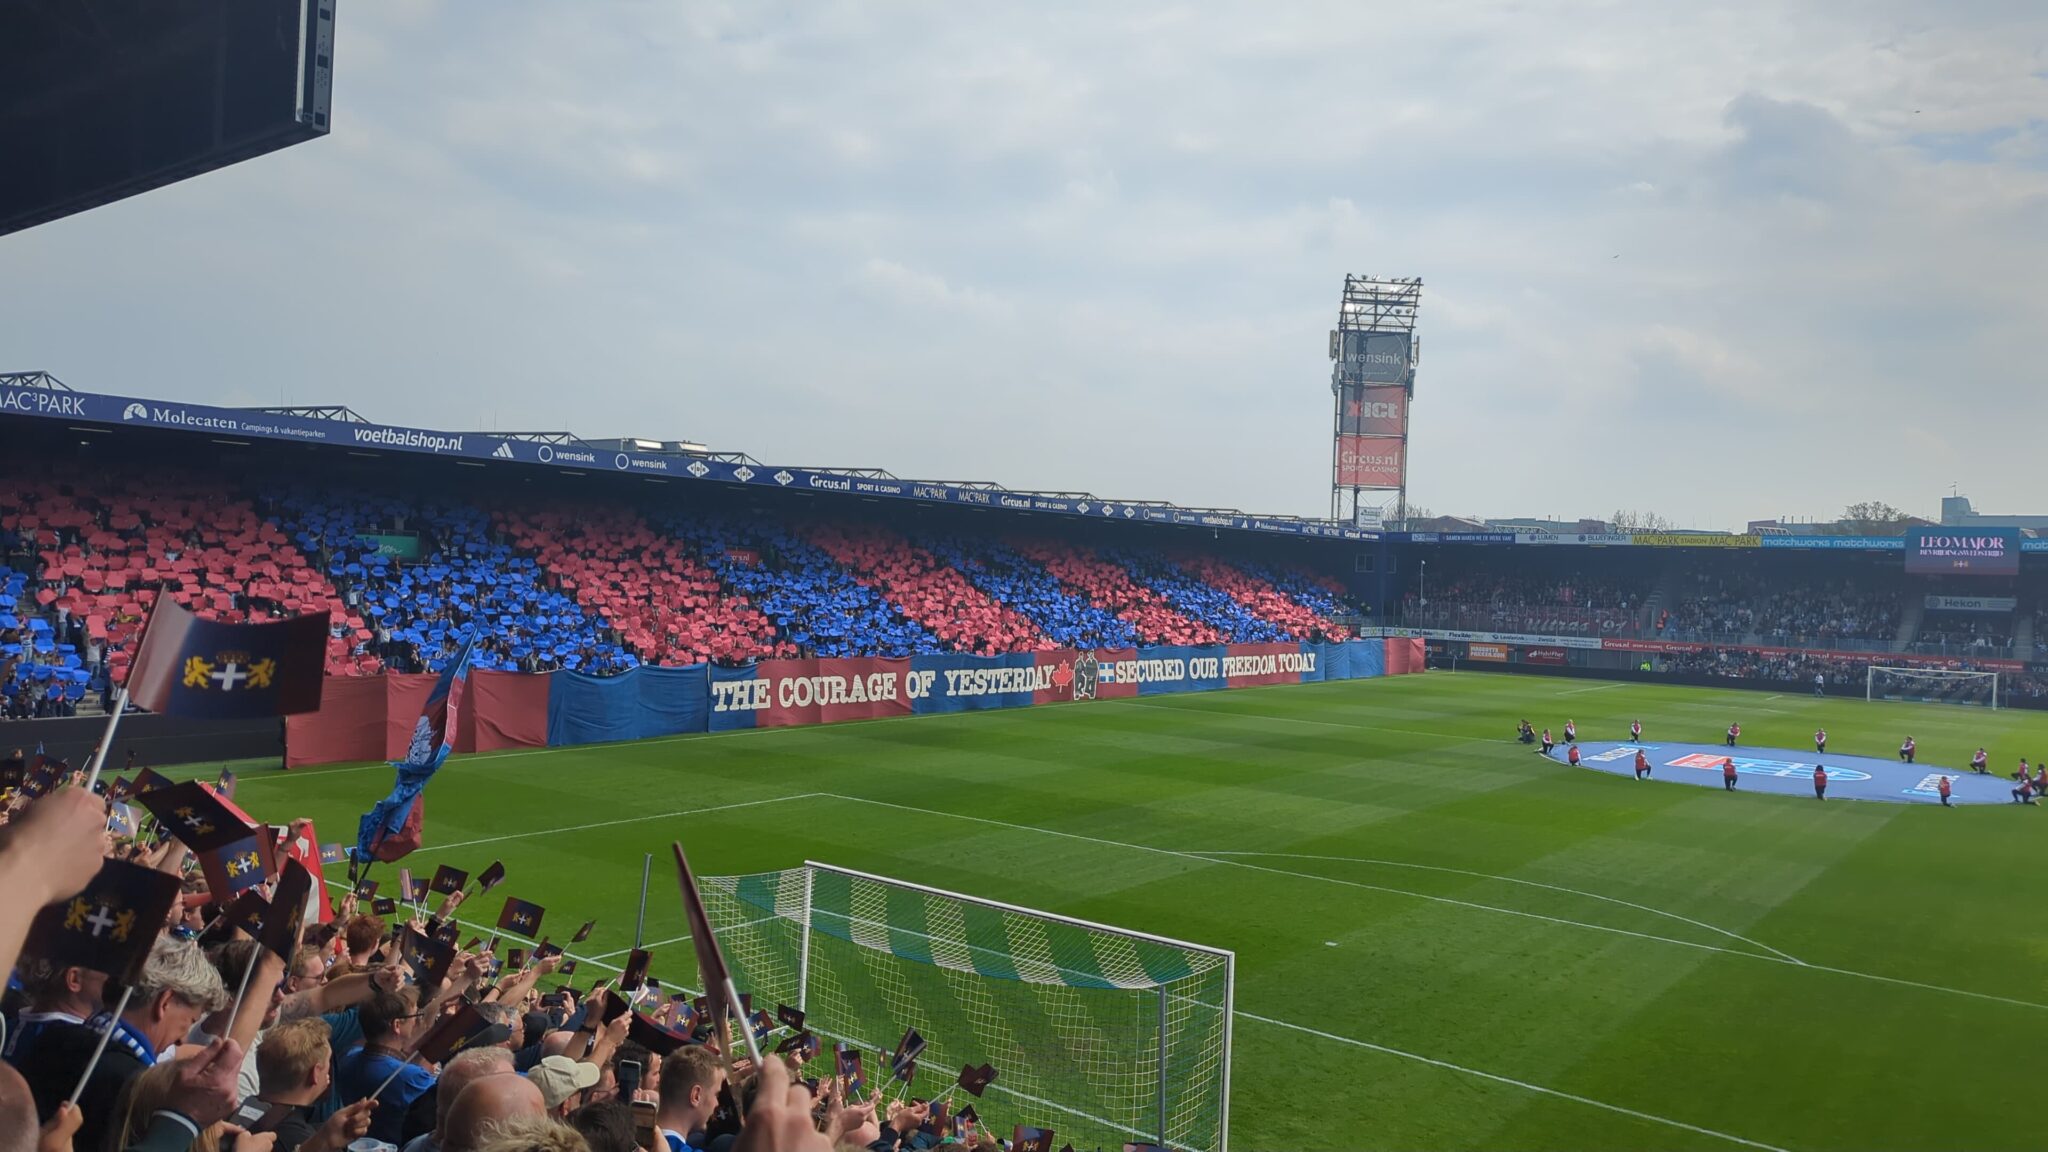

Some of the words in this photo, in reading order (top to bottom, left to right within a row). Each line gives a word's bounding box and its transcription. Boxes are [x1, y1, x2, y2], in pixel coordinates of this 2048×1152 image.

[1346, 352, 1401, 365] wensink
[153, 408, 237, 429] Molecaten
[241, 421, 273, 435] Campings
[273, 426, 279, 434] &
[280, 427, 326, 438] vakantieparken
[354, 428, 463, 452] voetbalshop.nl
[556, 451, 595, 463] wensink
[1341, 451, 1398, 465] Circus.nl
[631, 458, 667, 470] wensink
[810, 475, 851, 490] Circus.nl
[857, 483, 873, 491] SPORT
[880, 486, 901, 494] CASINO
[1763, 538, 1830, 547] matchworks
[1833, 538, 1904, 548] matchworks
[1920, 536, 1951, 548] LEO
[1952, 537, 2004, 549] MAJOR
[1944, 599, 1982, 608] Hekon
[712, 679, 771, 712] THE
[779, 672, 897, 708] COURAGE
[905, 670, 935, 699] OF
[944, 664, 1055, 696] YESTERDAY
[1115, 659, 1184, 684] SECURED
[1189, 657, 1218, 680] OUR
[1222, 654, 1276, 677] FREEDOM
[1278, 653, 1316, 672] TODAY
